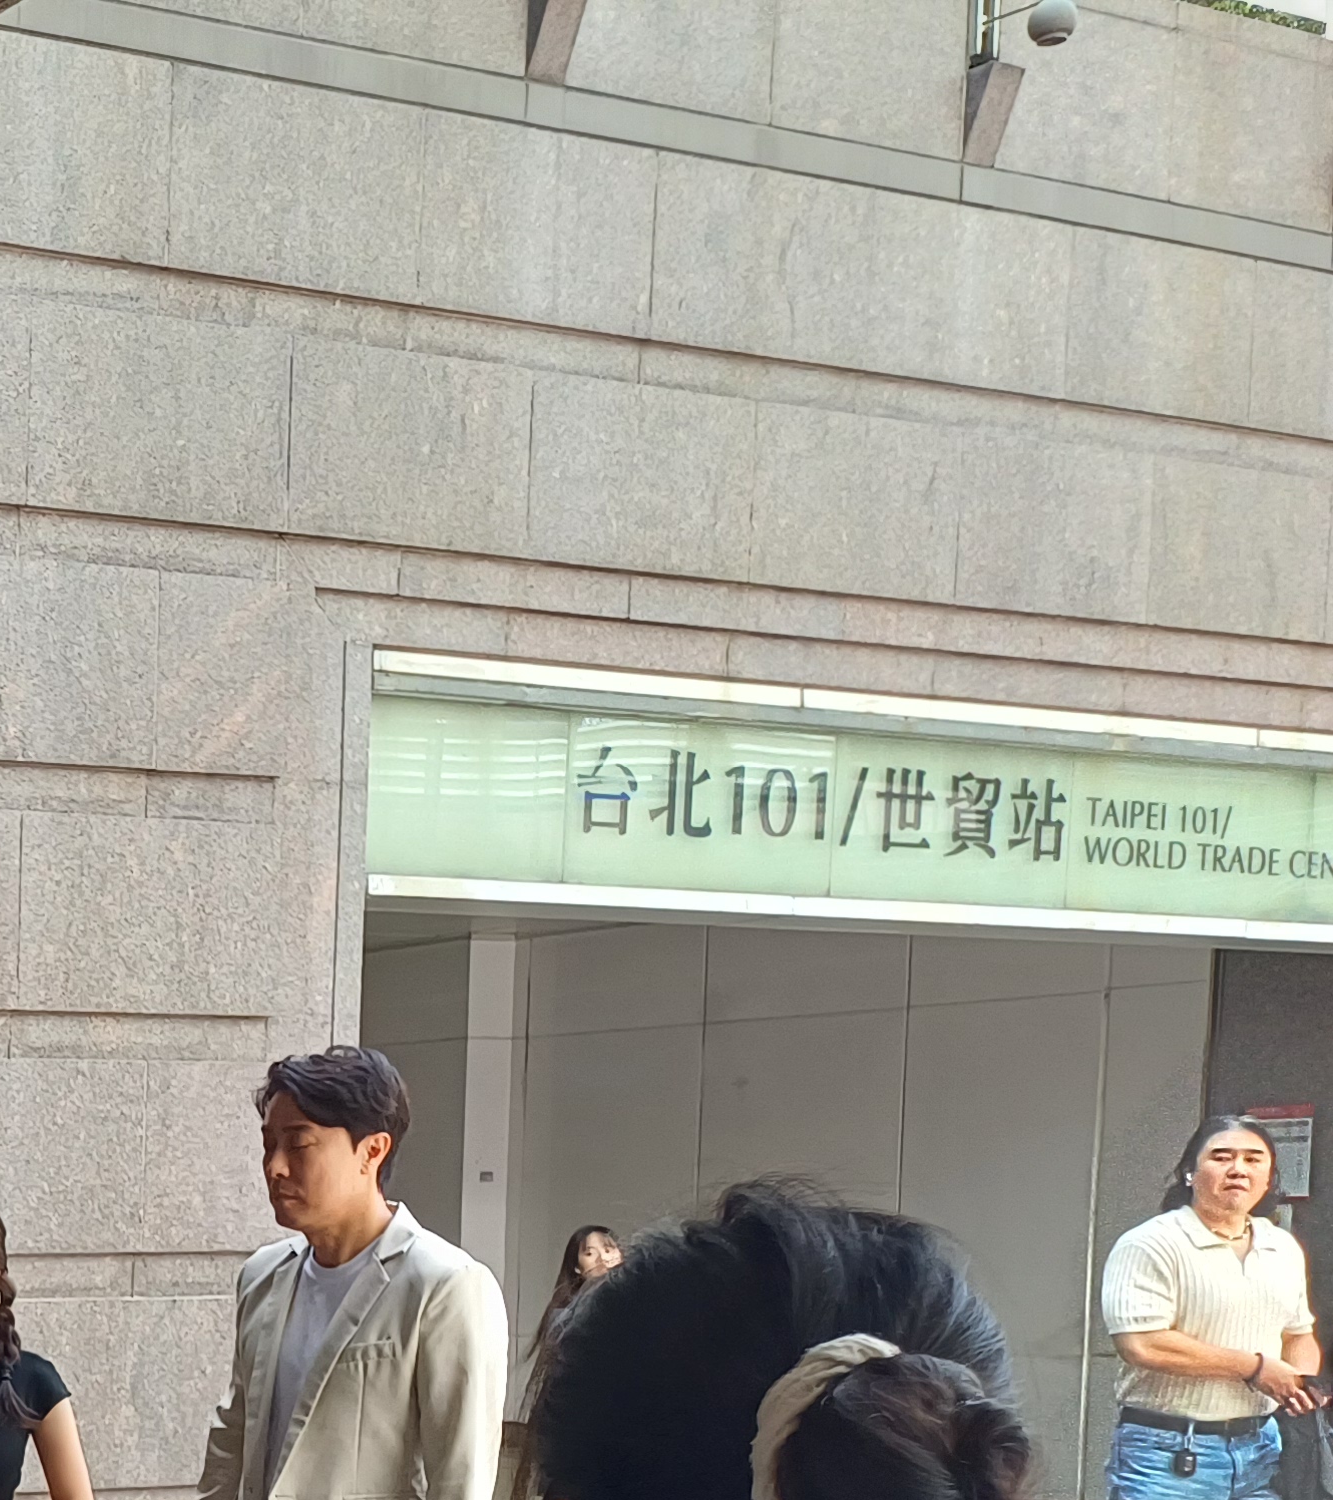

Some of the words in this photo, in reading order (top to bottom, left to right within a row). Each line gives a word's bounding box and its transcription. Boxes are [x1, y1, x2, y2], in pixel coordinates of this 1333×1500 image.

[577, 746, 1067, 862] 台北101/世貿站
[1086, 797, 1167, 831] TAIPEI
[1179, 805, 1233, 840] 101/
[1084, 835, 1187, 870] WORLD
[1197, 842, 1281, 876] TRADE
